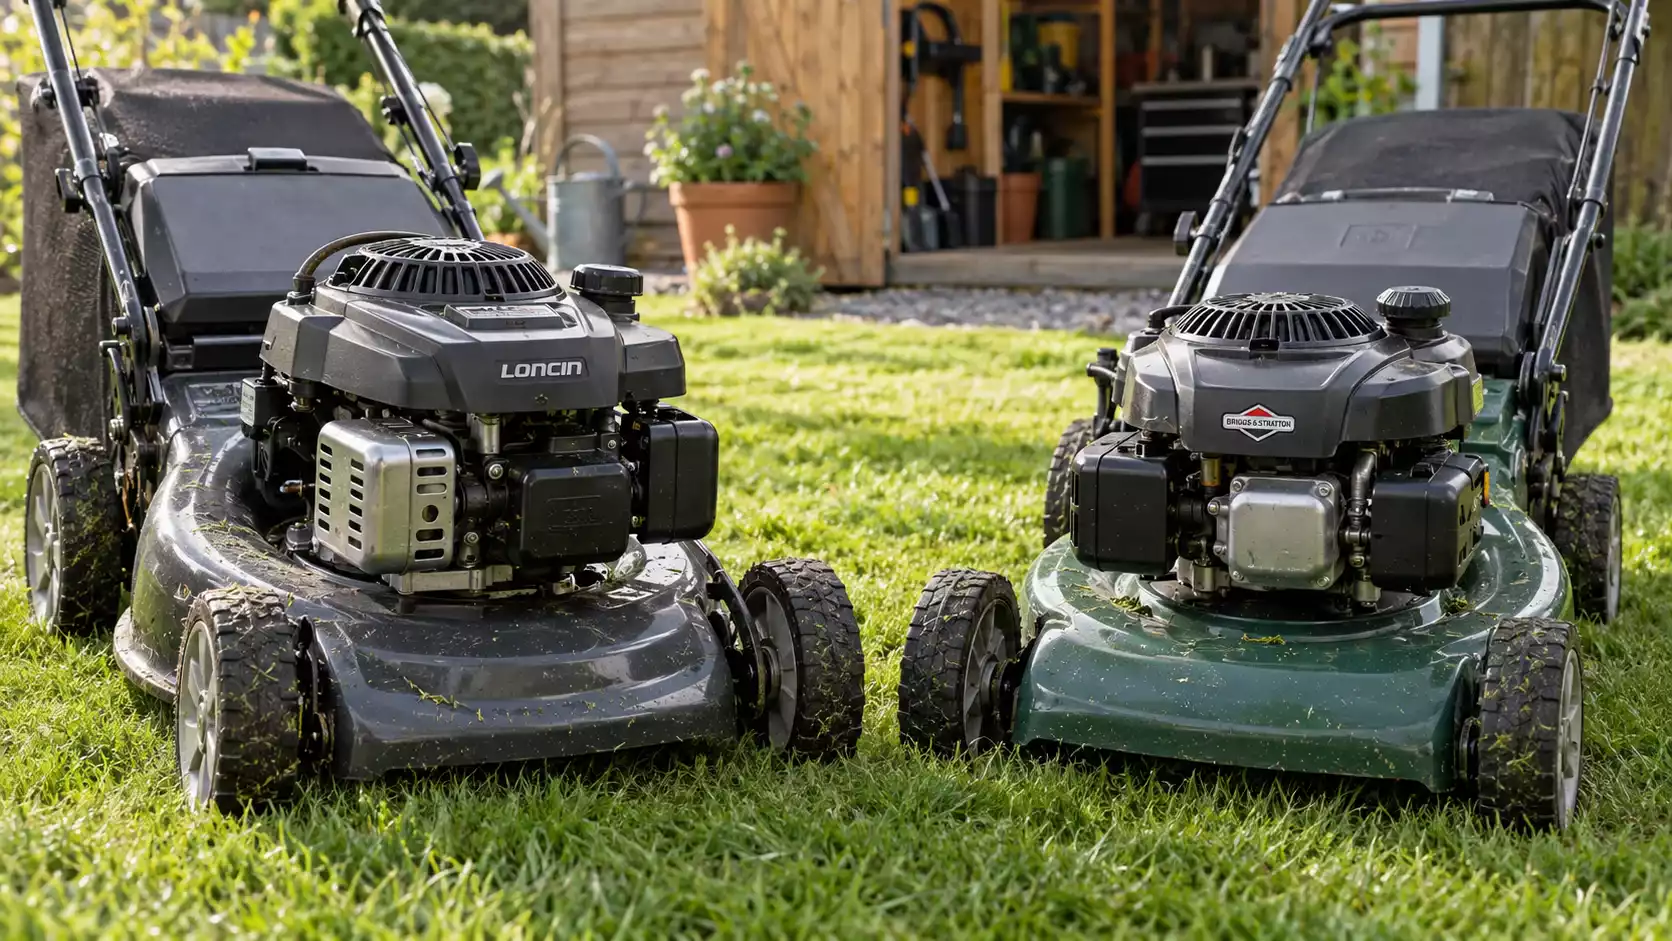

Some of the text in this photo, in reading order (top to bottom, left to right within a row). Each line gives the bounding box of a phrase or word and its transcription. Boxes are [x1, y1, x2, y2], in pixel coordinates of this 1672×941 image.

[501, 361, 582, 379] LONCIN
[1226, 418, 1252, 426] BRIGGS
[1257, 419, 1292, 428] STRATTON
